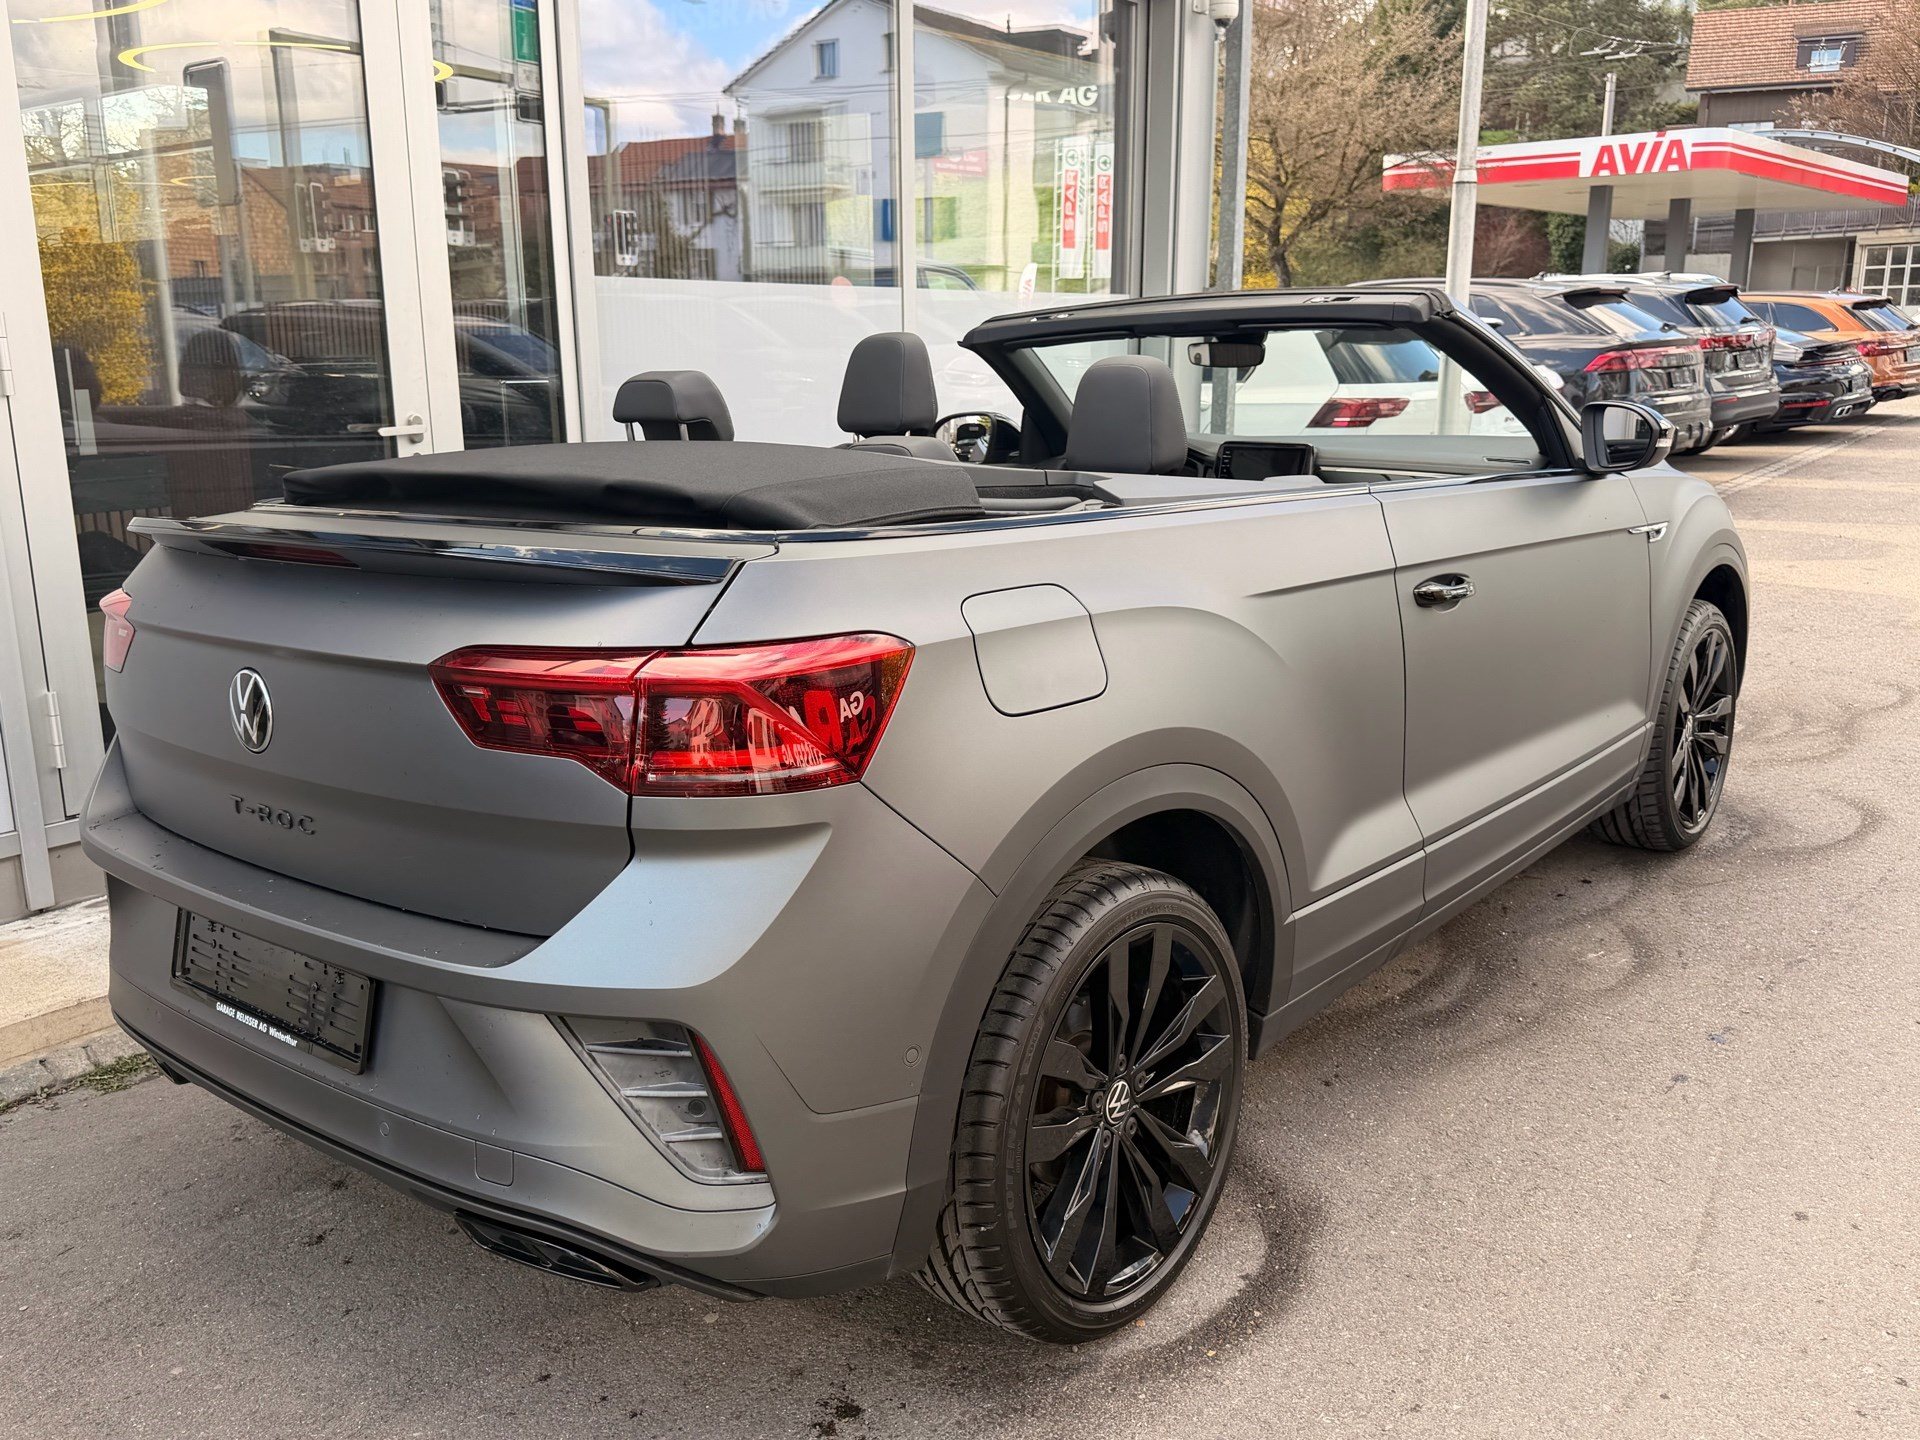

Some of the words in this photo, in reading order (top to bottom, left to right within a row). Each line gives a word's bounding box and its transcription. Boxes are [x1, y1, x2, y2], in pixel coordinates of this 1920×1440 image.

[1057, 85, 1099, 107] AG
[1064, 171, 1077, 232] SPAR
[1097, 175, 1110, 234] SPAR
[230, 794, 316, 836] T-ROC
[216, 1001, 236, 1018] GARAGE
[236, 1011, 259, 1029] REUSSER
[258, 1021, 268, 1033] AG
[269, 1026, 298, 1047] Winterthur
